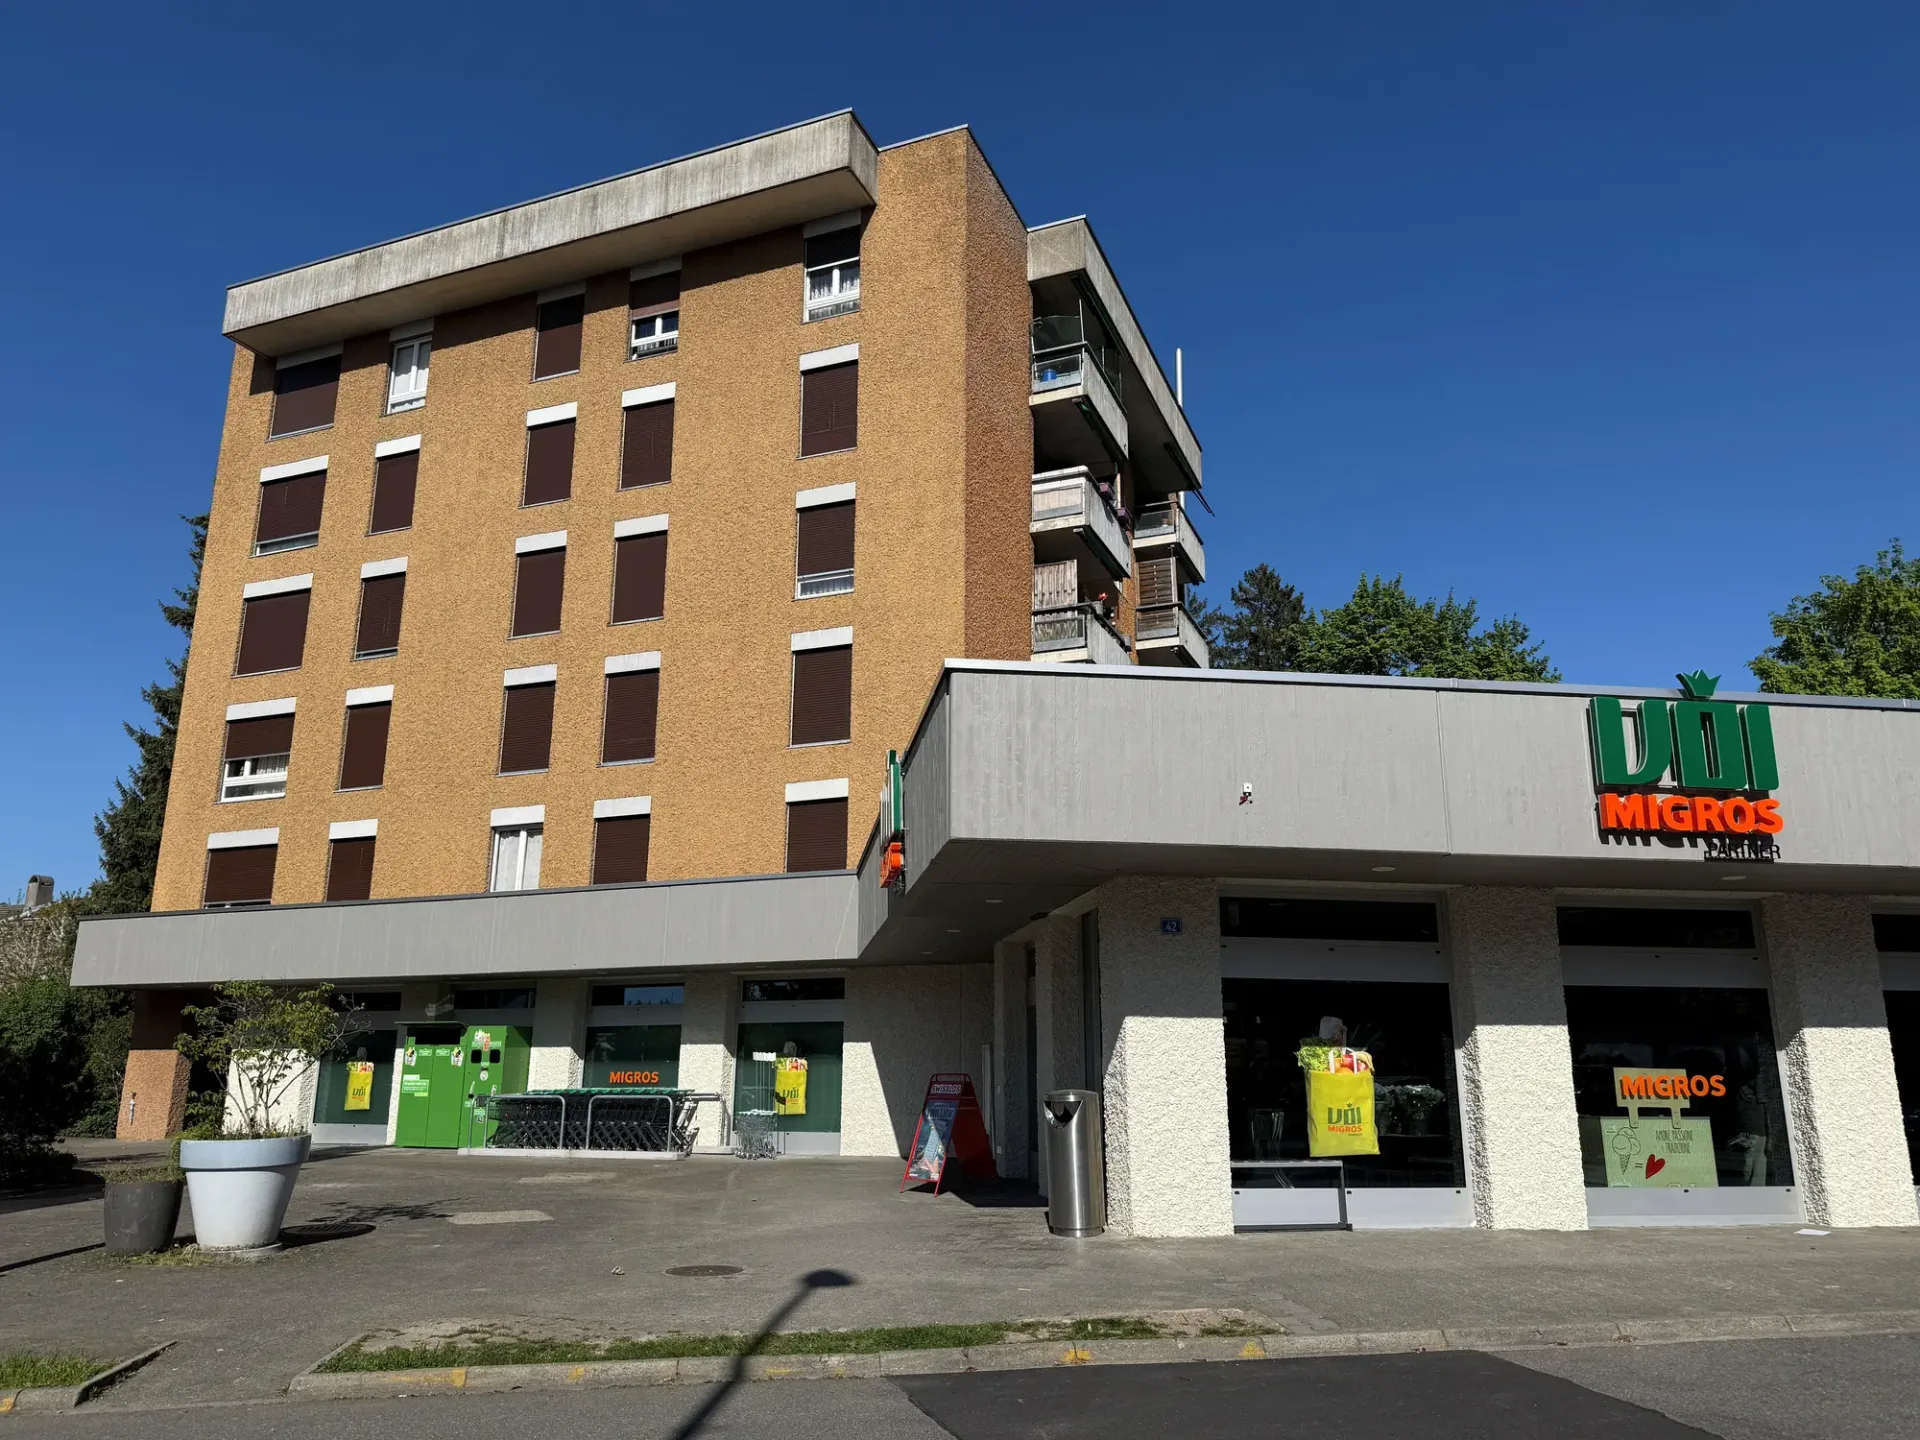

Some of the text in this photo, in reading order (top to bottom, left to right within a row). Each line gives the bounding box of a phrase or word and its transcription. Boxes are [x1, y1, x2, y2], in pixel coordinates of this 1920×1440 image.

[1599, 793, 1784, 834] MIGROS
[1707, 843, 1782, 860] PARTNER
[1165, 921, 1178, 932] 42
[609, 1071, 660, 1084] MIGROS
[931, 1084, 962, 1094] SWISSLOS
[1621, 1074, 1726, 1097] MIGROS
[1328, 1125, 1363, 1133] MIGROS
